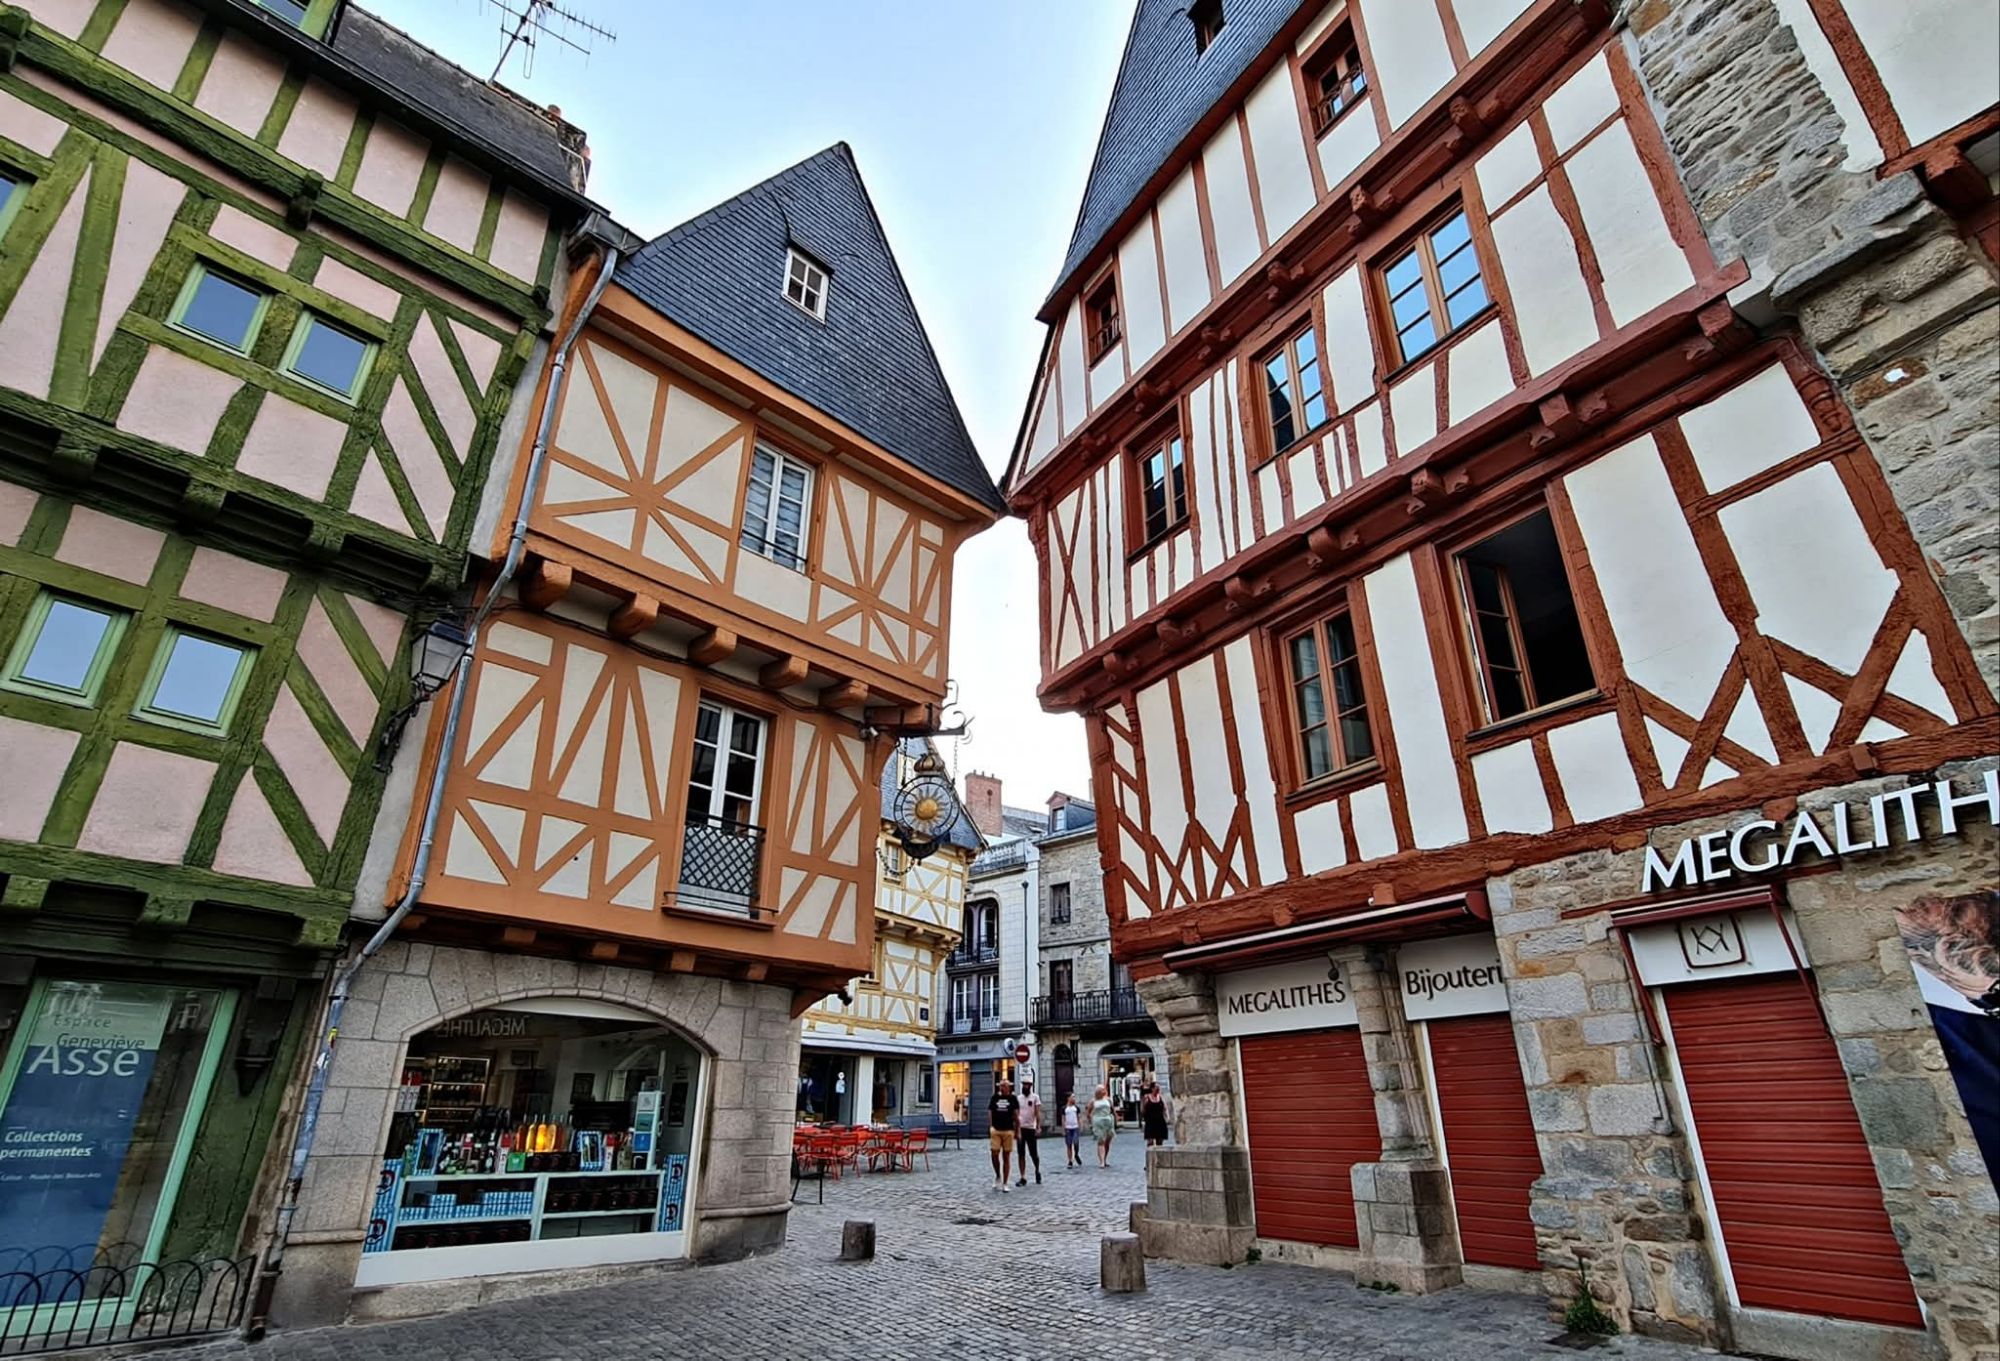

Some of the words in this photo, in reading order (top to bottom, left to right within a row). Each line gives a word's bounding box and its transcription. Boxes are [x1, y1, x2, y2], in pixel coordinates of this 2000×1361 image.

[1642, 769, 1999, 893] MEGALITH
[1405, 959, 1504, 1000] Bijouteri
[1228, 980, 1346, 1015] MEGALITHES
[56, 1032, 146, 1049] Geneviève
[26, 1044, 141, 1077] Asse
[0, 1146, 94, 1160] permanentes
[5, 1131, 84, 1143] Collections
